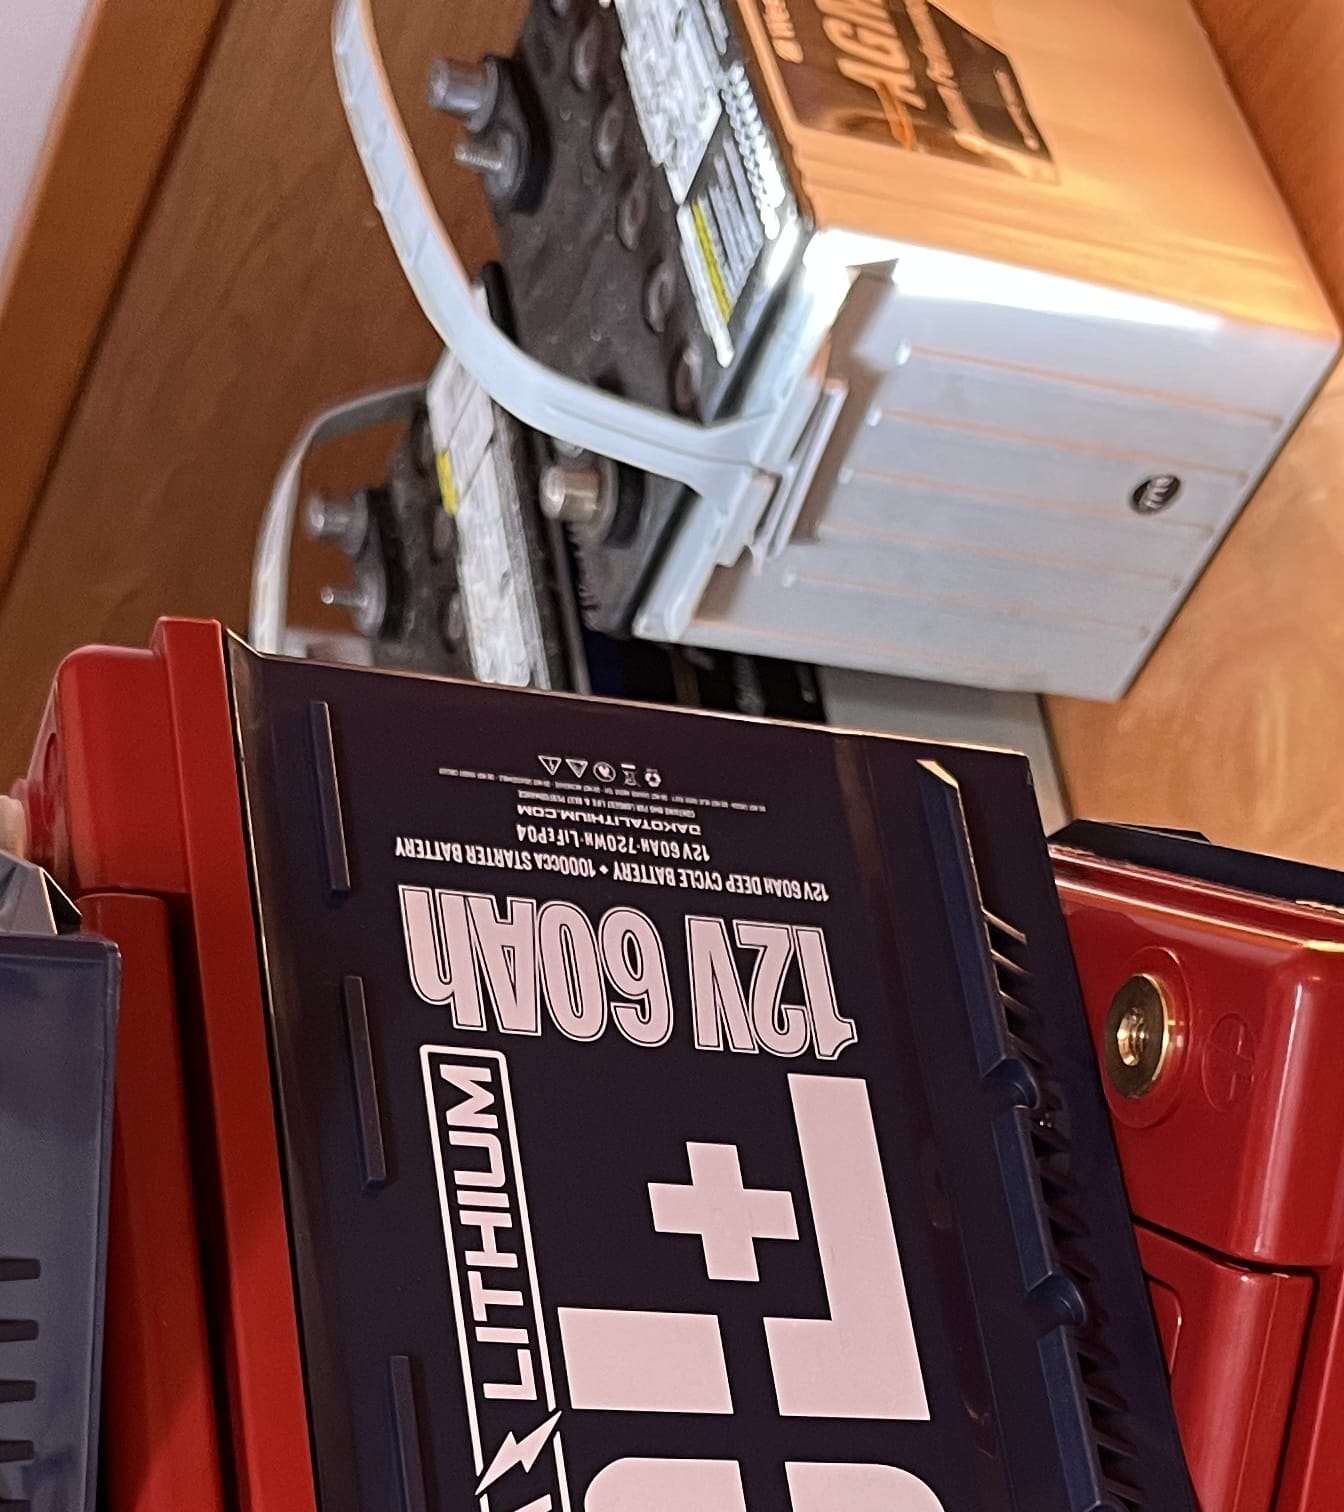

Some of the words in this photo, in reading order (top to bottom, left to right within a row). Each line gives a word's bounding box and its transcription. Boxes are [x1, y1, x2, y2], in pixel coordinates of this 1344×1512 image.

[517, 805, 701, 835] DAKOTALITHIUM.COM
[396, 837, 462, 863] BATTERY
[465, 845, 532, 870] STARTER
[683, 843, 710, 861] 12V
[614, 861, 676, 886] BATTERY
[677, 869, 722, 891] CYCLE
[726, 874, 762, 895] DEEP
[804, 882, 829, 901] 12V
[398, 885, 673, 1047] 60Ah
[685, 915, 858, 1060] 12V
[440, 1064, 537, 1400] LITHIUM
